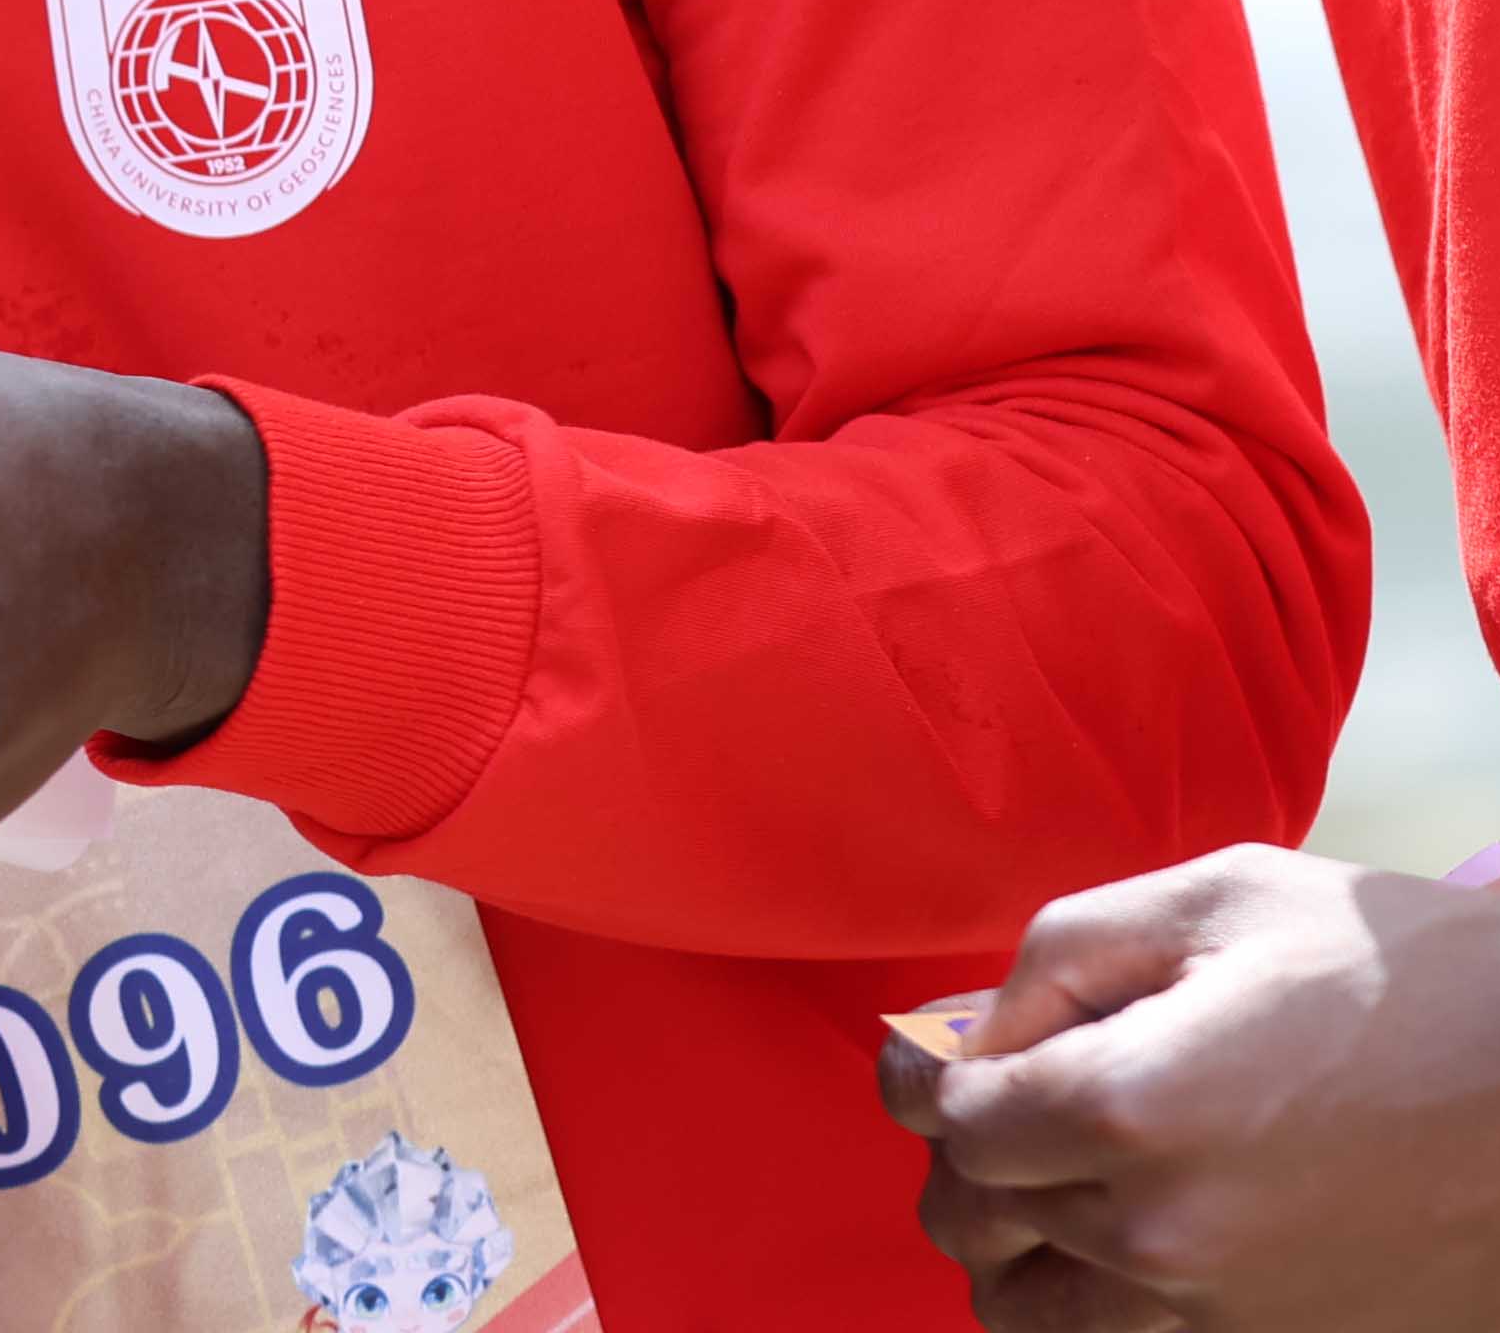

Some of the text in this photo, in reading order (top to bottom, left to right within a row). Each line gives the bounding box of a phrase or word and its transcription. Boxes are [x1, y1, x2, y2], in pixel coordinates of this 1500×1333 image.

[86, 51, 346, 218] CHINA UNIVERSITY OF GEOSCIENCES
[205, 153, 247, 176] 1952
